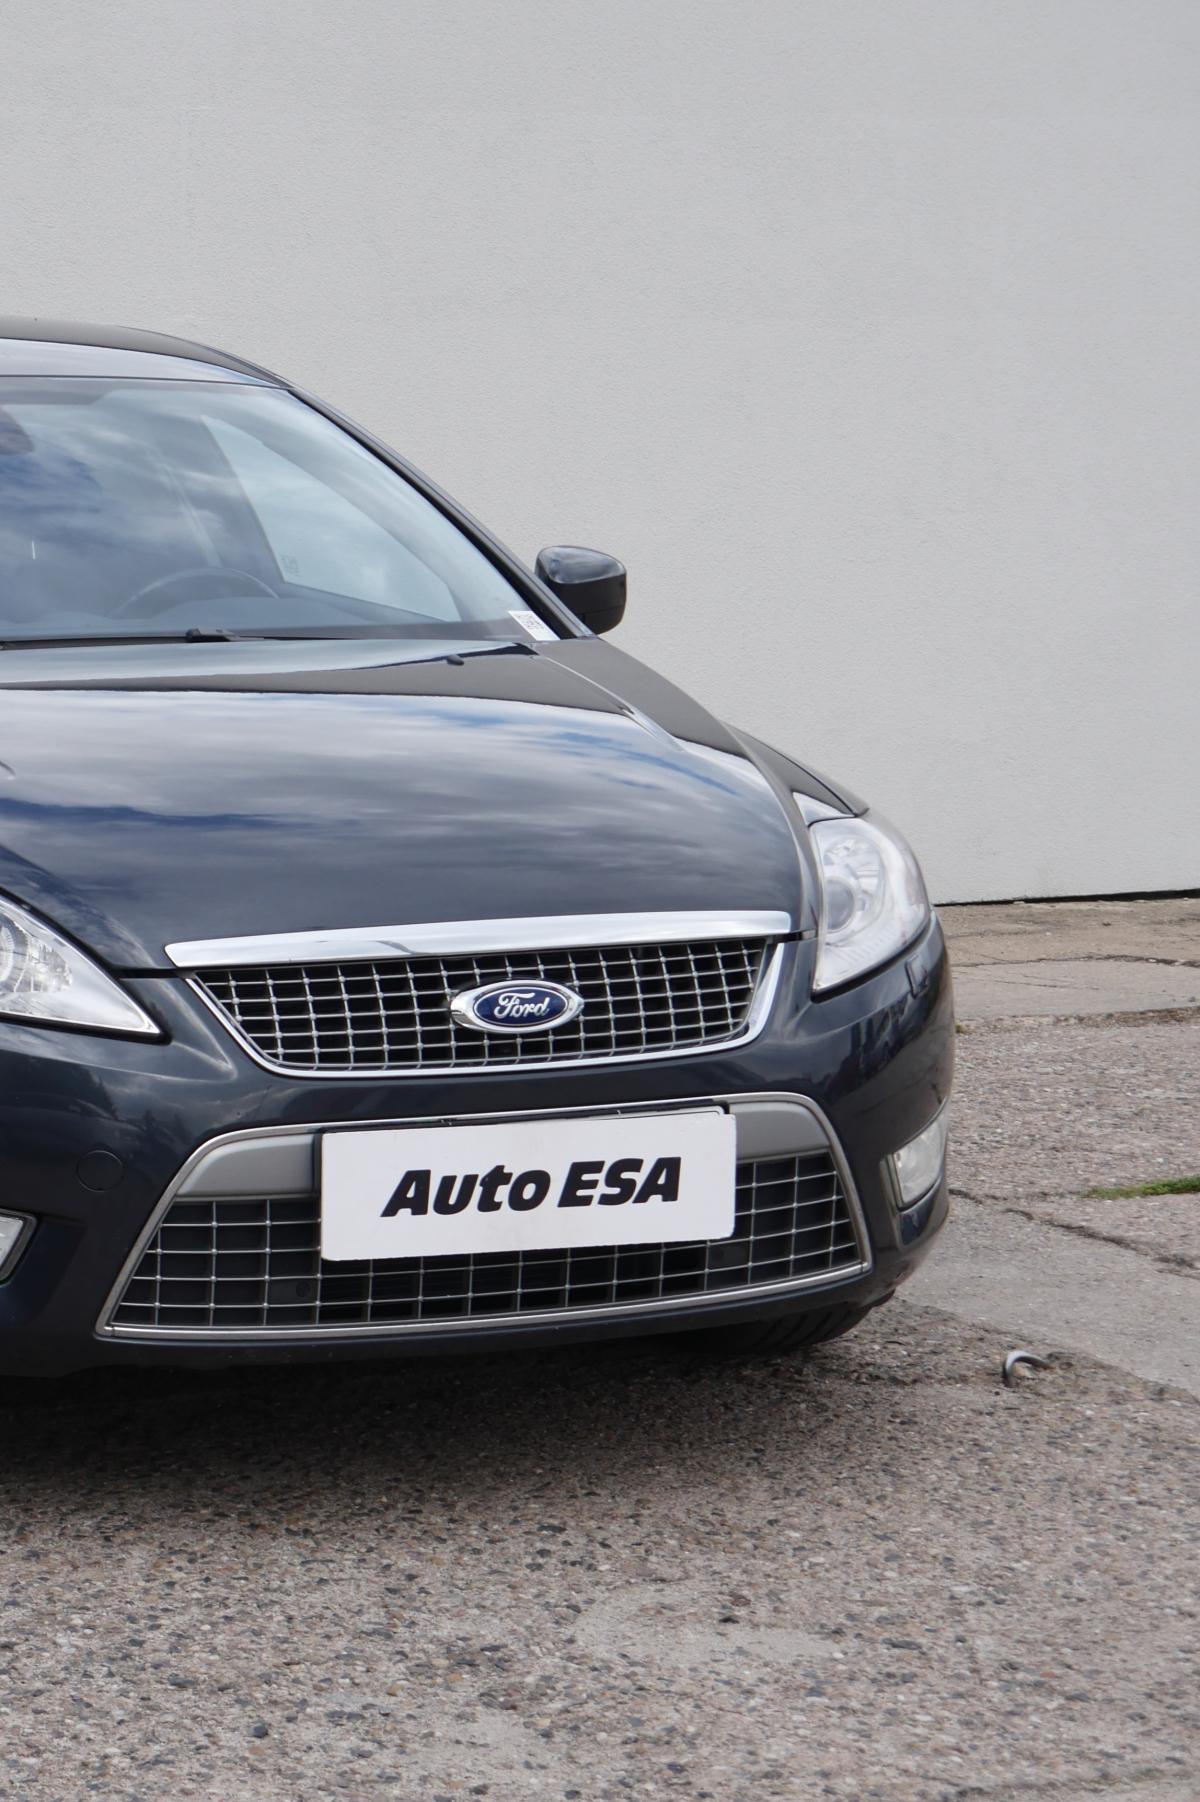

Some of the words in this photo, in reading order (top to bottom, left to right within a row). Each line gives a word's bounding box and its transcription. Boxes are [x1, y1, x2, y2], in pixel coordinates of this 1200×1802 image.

[493, 992, 551, 1019] Ford
[380, 1164, 551, 1218] Auto
[557, 1156, 682, 1208] ESA
